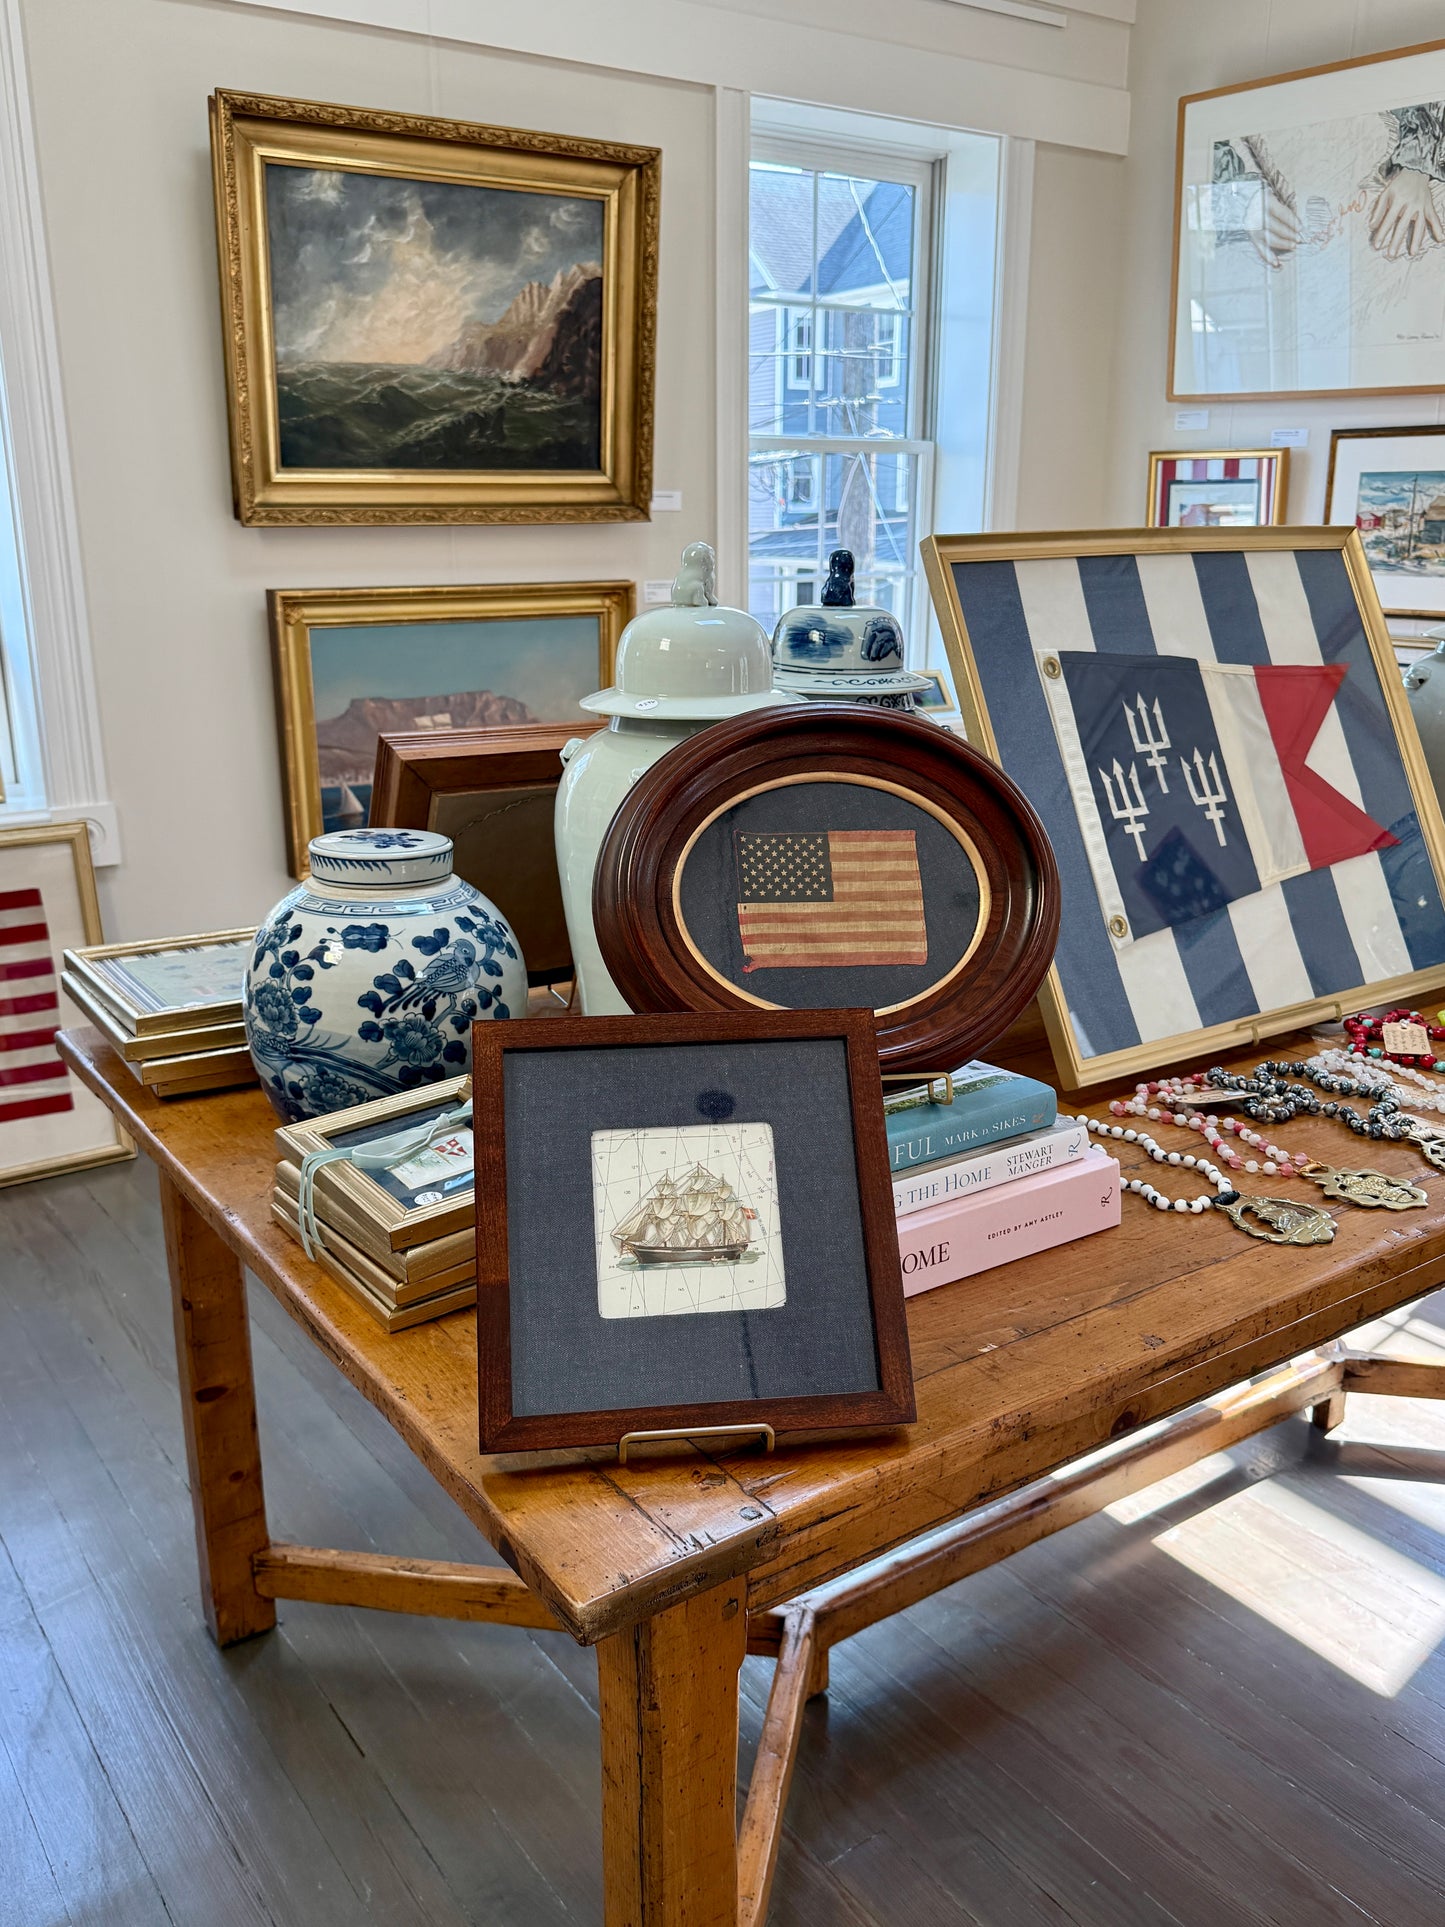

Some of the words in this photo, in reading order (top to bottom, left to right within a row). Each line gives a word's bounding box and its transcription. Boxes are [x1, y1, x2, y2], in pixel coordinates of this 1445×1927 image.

[893, 1136, 936, 1165] FUL
[943, 1128, 979, 1147] MARK
[991, 1114, 1026, 1132] SIKES
[1006, 1144, 1054, 1167] STEWART
[1008, 1156, 1052, 1177] MANGER
[907, 1181, 939, 1205] THE
[987, 1227, 1011, 1240] EDITED
[1014, 1224, 1022, 1233] BY
[1024, 1219, 1038, 1229] AMY
[1040, 1210, 1064, 1224] ASTLEY
[900, 1241, 950, 1275] OME
